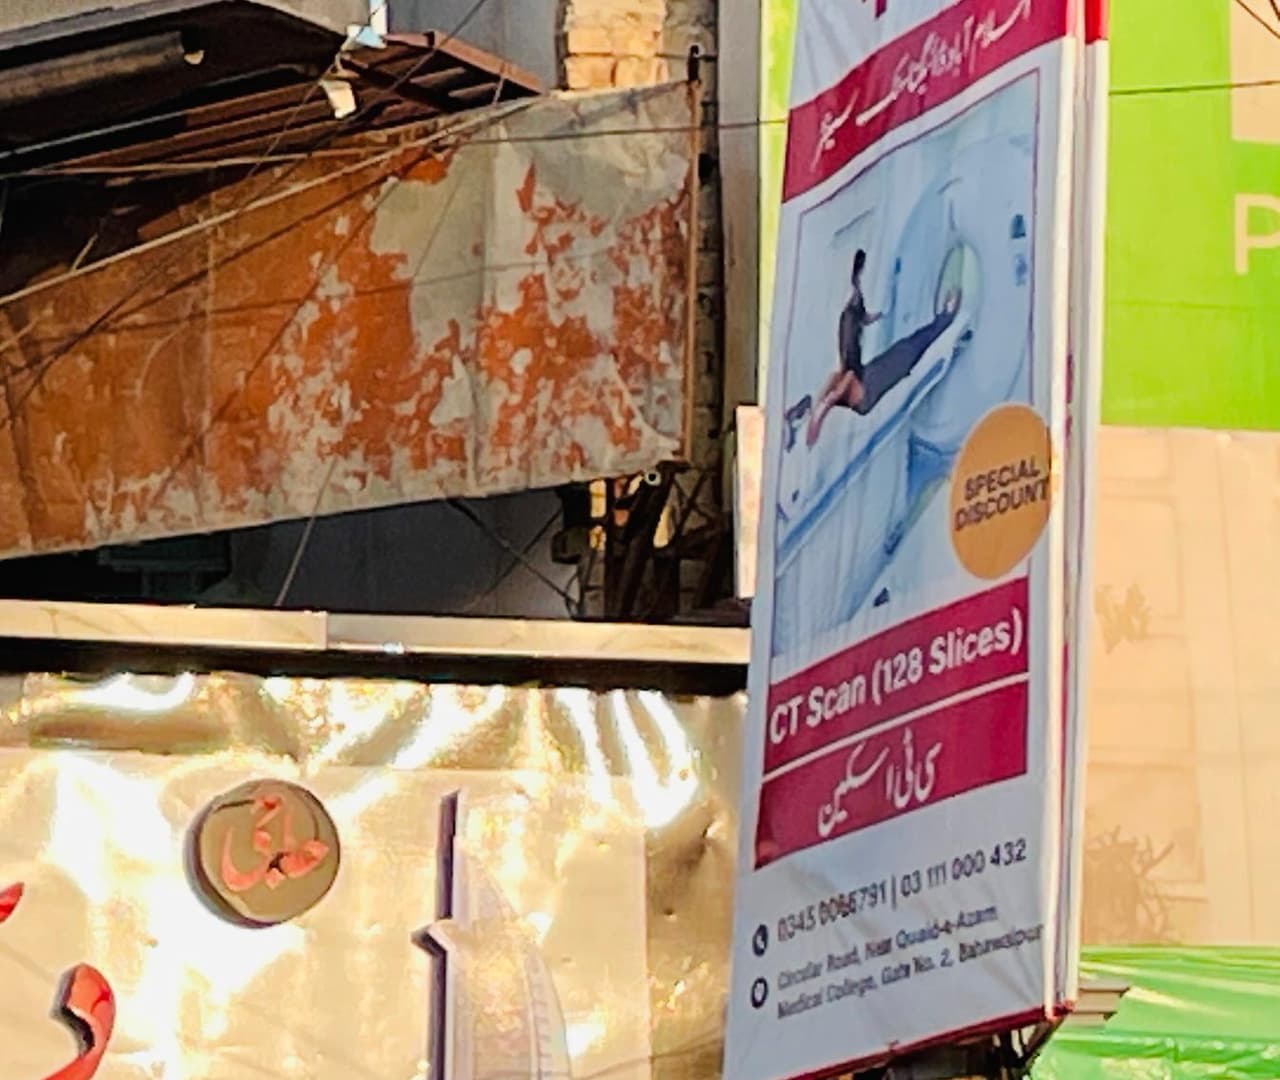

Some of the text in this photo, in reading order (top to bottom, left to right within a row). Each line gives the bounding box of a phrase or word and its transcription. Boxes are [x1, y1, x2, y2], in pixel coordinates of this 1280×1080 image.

[955, 478, 1050, 531] DISCOUNT
[965, 455, 1040, 501] SPECIAL
[769, 606, 1024, 745] CT Scan (128 Slices)
[900, 869, 922, 898] 03
[990, 836, 1027, 867] 432
